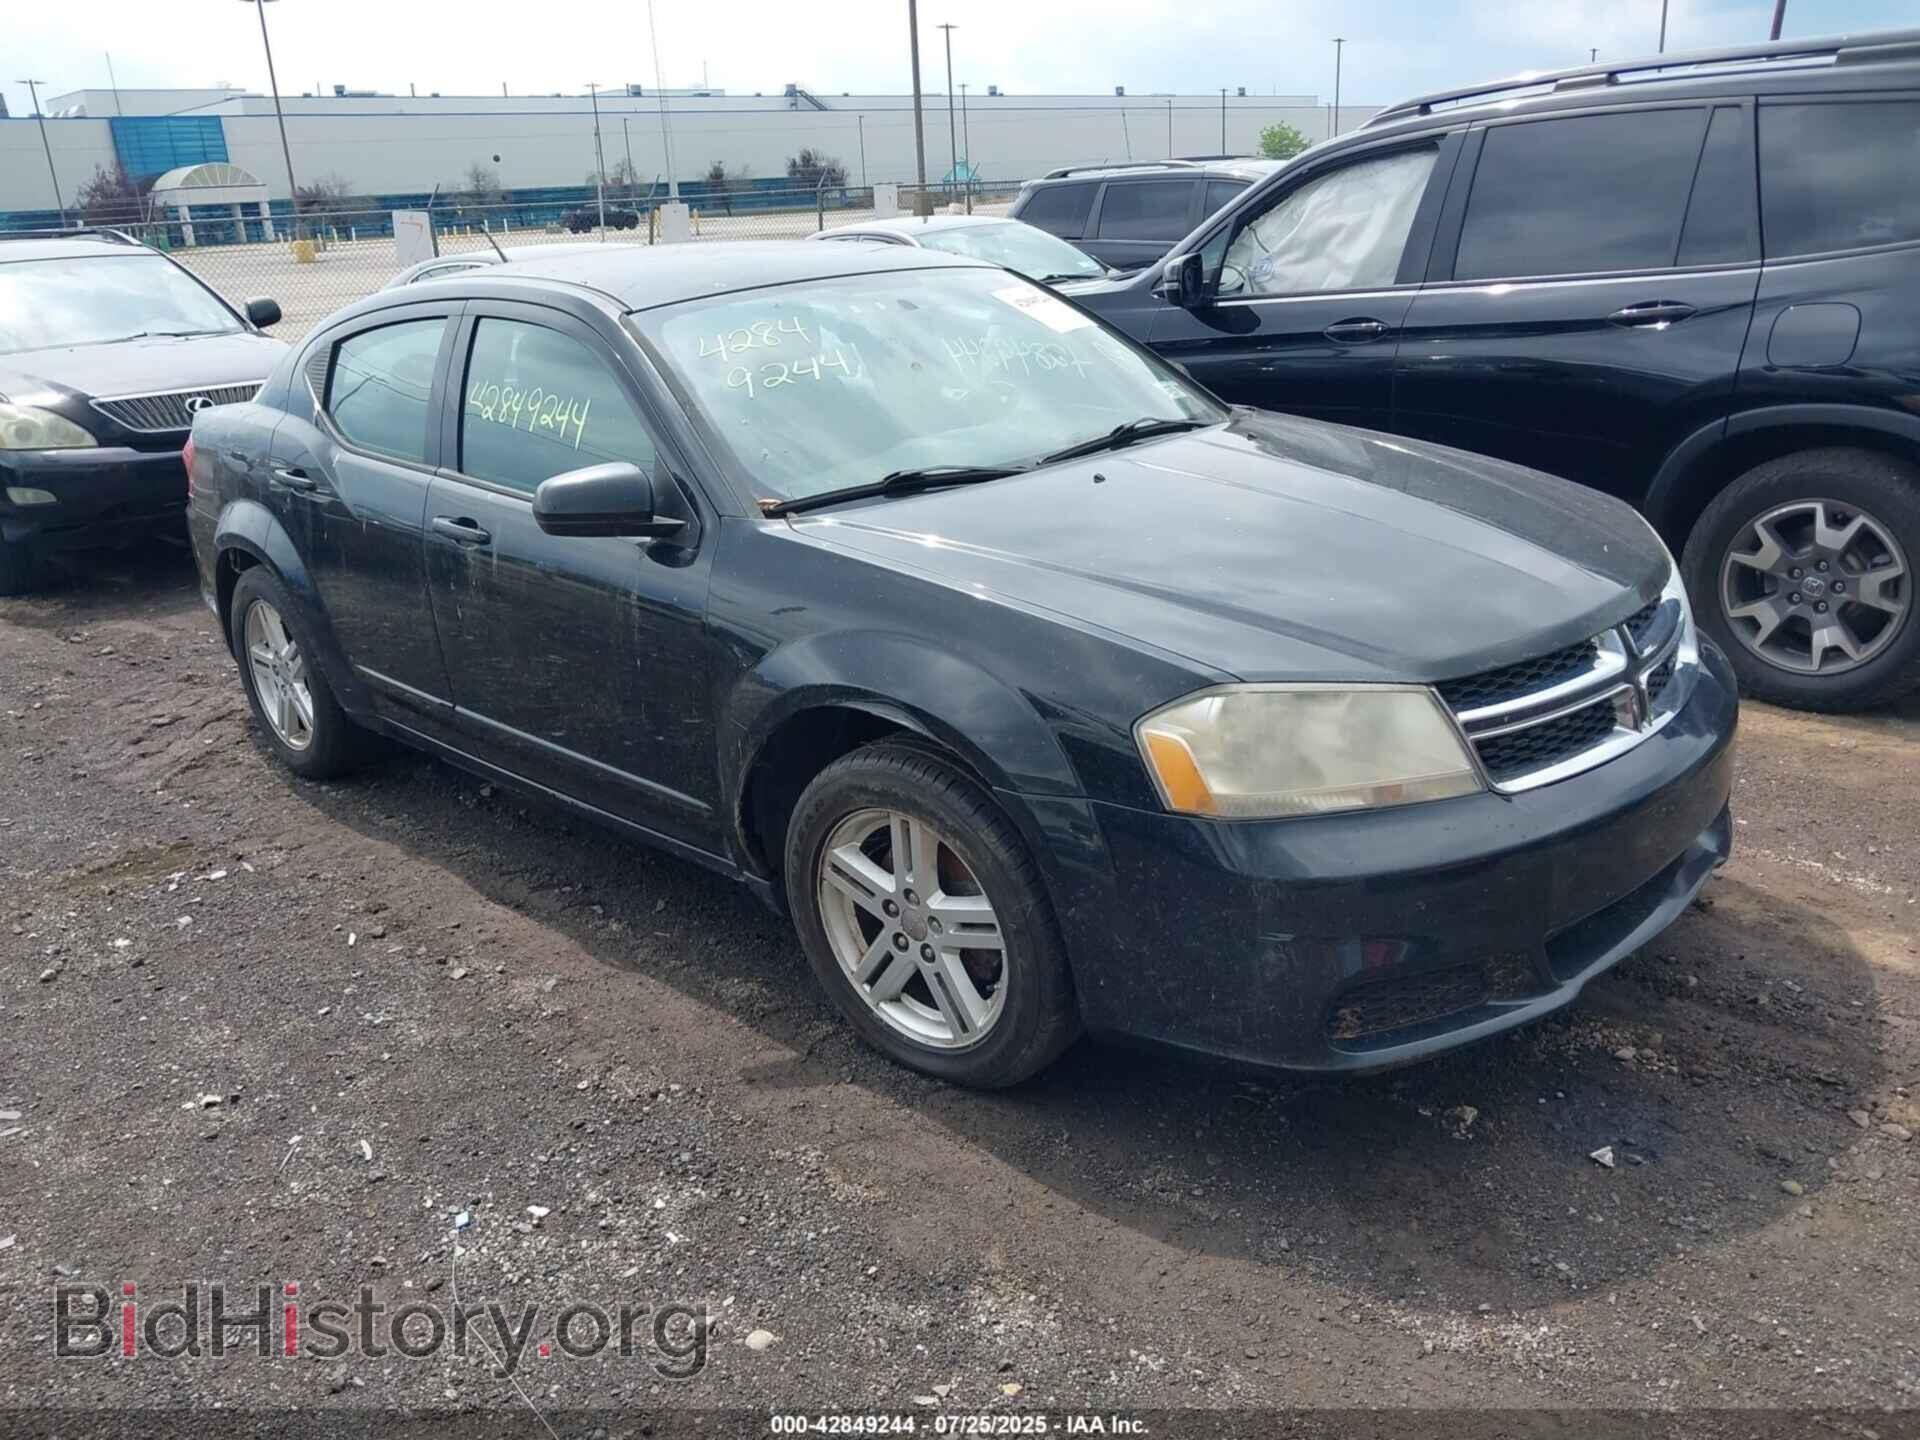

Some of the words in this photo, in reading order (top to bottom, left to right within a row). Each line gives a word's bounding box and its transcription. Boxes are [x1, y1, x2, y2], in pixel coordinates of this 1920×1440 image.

[698, 316, 811, 362] 4284
[727, 349, 851, 399] 9244
[469, 380, 592, 451] 42849244
